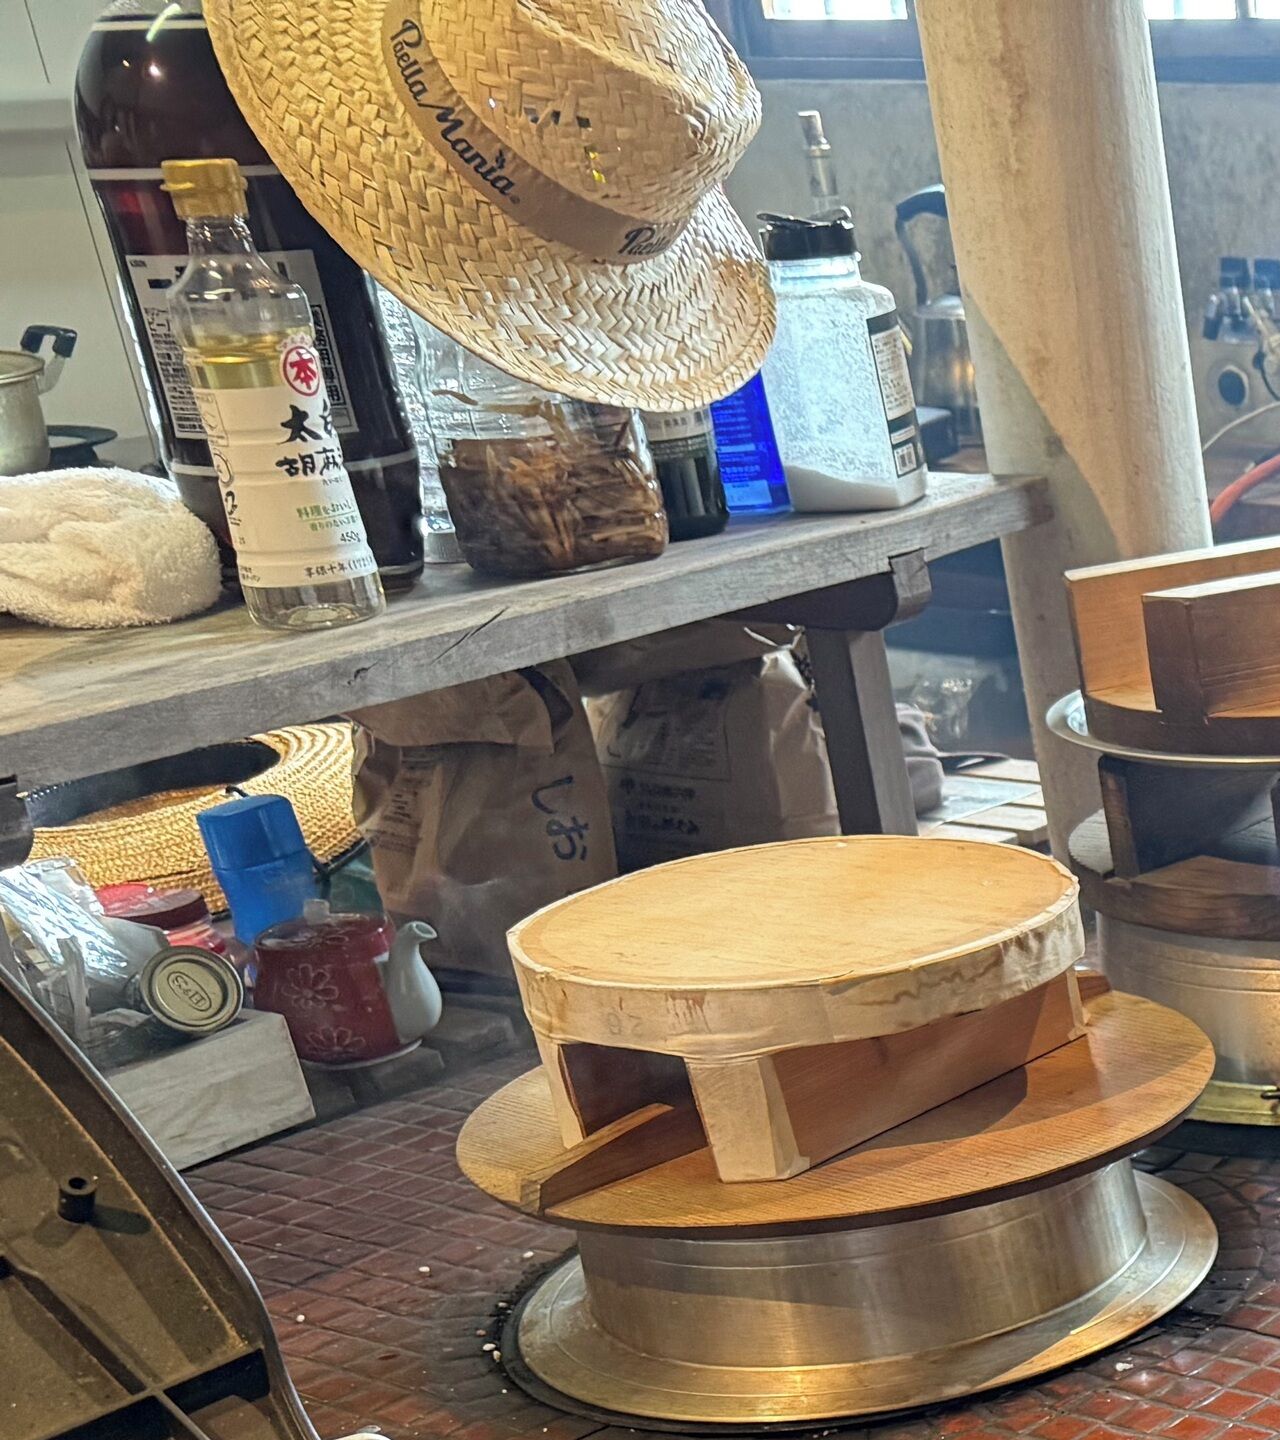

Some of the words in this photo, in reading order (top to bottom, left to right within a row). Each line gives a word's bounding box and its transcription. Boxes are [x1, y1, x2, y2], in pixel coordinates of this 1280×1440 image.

[389, 18, 429, 102] Paella
[417, 102, 516, 197] Mania
[531, 775, 589, 861] しお
